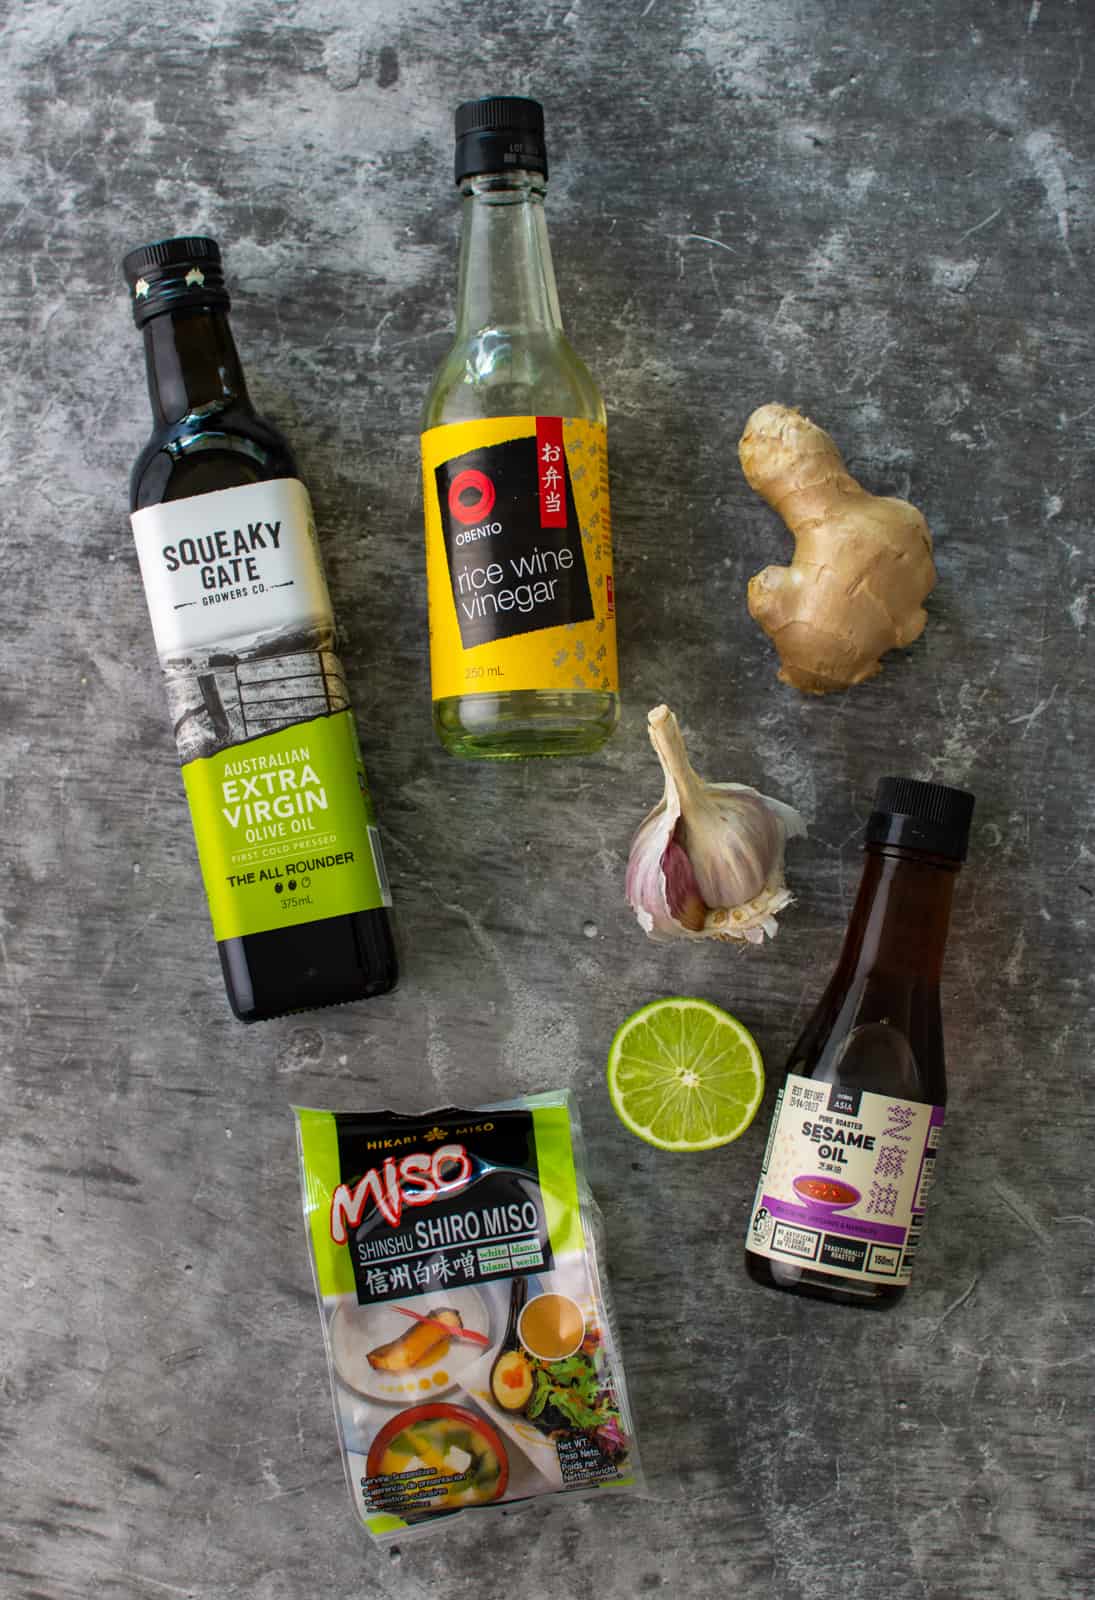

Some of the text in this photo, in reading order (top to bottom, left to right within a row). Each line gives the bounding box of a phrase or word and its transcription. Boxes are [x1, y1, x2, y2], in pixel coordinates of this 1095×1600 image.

[541, 442, 562, 513] お弁当
[163, 521, 282, 572] SQUEAKY
[455, 522, 502, 546] OBENTO
[200, 557, 261, 590] GATE
[458, 546, 574, 595] rice wine
[202, 583, 269, 606] GROWERS CO.
[462, 578, 558, 620] vinegar
[487, 664, 505, 677] mL
[224, 746, 311, 777] AUSTRALIAN
[222, 764, 321, 804] EXTRA
[223, 787, 329, 829] VIRGIN
[246, 817, 316, 844] OLIVE OIL
[231, 834, 338, 865] FIRST COLD PRESSED
[226, 851, 355, 888] THE ALL ROUNDER
[833, 1100, 854, 1111] ASIA
[367, 1122, 494, 1150] HIKARI MISO
[801, 1121, 876, 1151] SESAME
[835, 1118, 863, 1130] ROASTED
[817, 1143, 848, 1164] OIL
[358, 1201, 538, 1261] SHINSHU SHIRO MISO
[479, 1246, 508, 1258] white
[365, 1250, 477, 1296] 信州白味噌
[558, 1441, 573, 1451] Net
[560, 1452, 579, 1461] Peso
[561, 1462, 583, 1471] Poids
